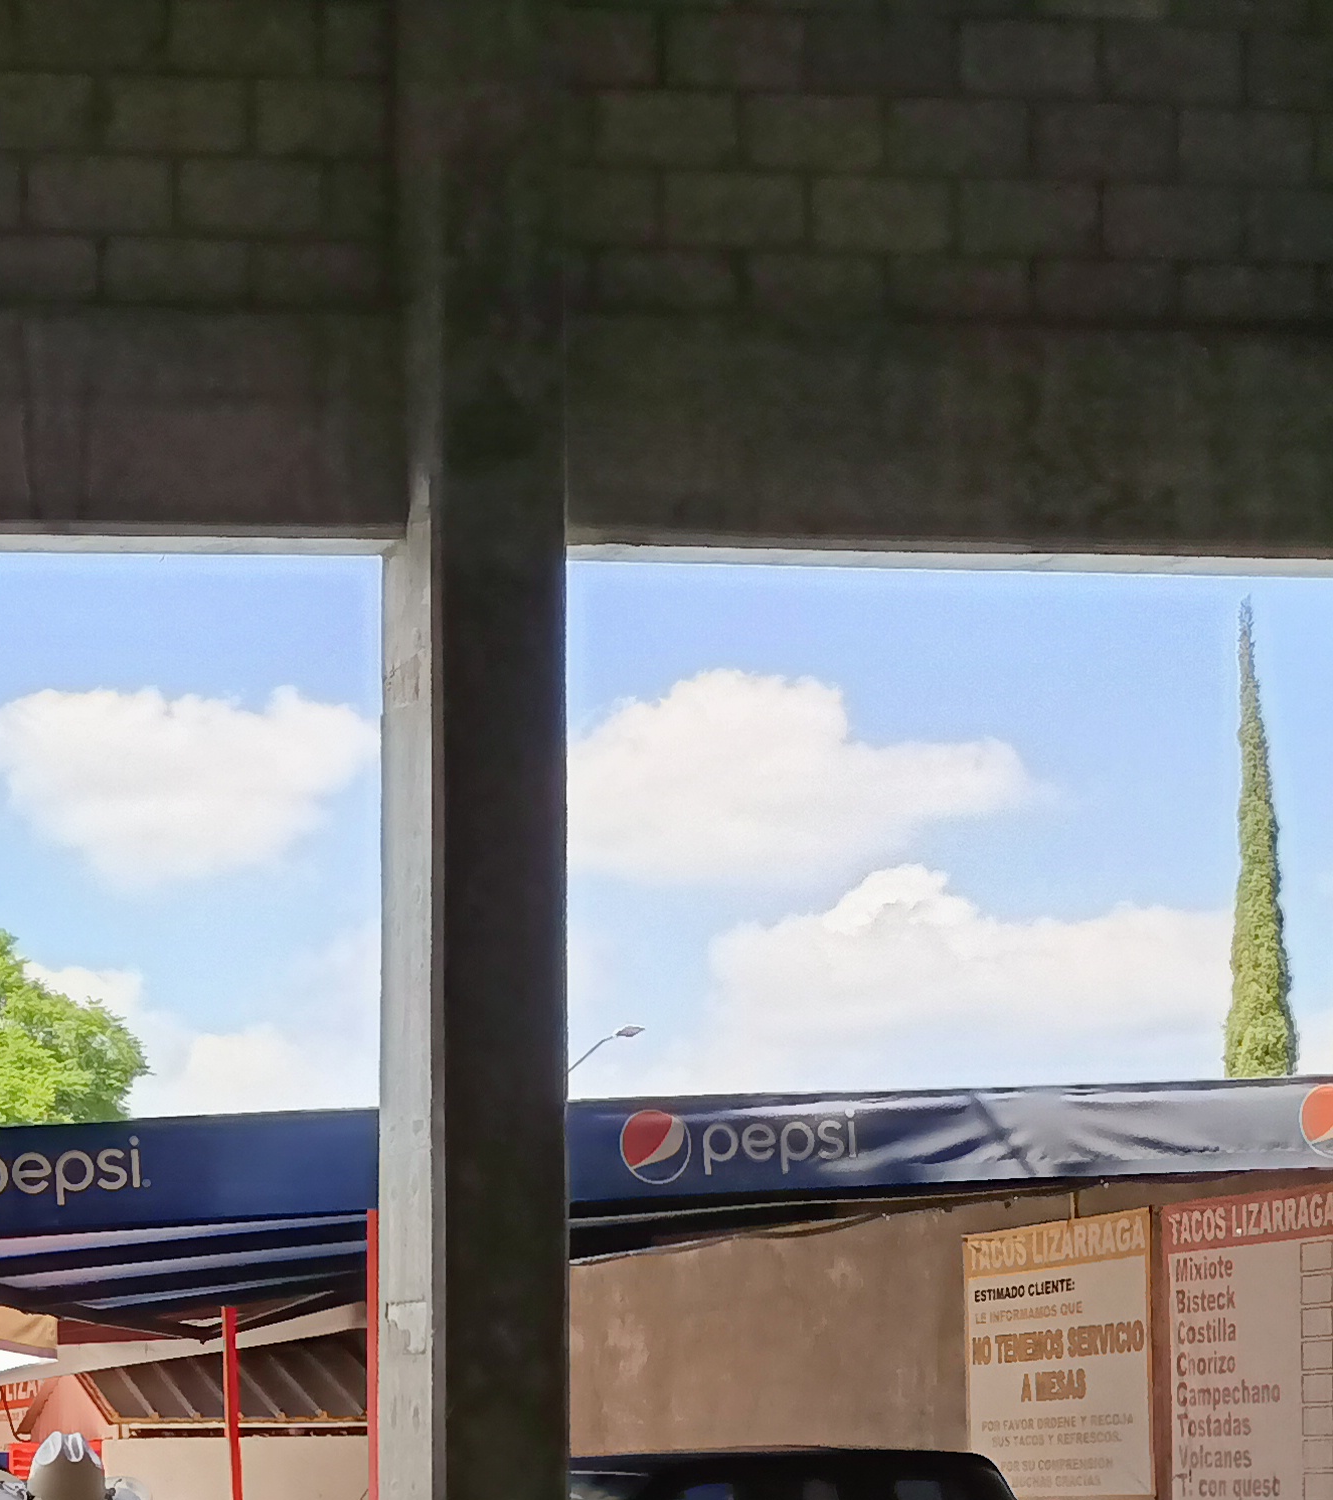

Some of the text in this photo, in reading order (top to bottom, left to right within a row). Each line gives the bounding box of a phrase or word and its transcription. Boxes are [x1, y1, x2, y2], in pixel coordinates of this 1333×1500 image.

[703, 1108, 860, 1176] pepsi
[1168, 1191, 1333, 1246] TACOS LIZARRAGA
[967, 1215, 1146, 1271] TACOS LIZARRAGA
[1175, 1255, 1234, 1283] Mixiote
[974, 1278, 1076, 1303] ESTIMADO CLIENTE:
[1176, 1285, 1236, 1314] Bisteck
[989, 1304, 1058, 1324] INFORMAMOS
[1060, 1301, 1084, 1316] QUE
[971, 1319, 1145, 1366] NO TENEMOS SERVICIO
[1177, 1317, 1237, 1345] Costilla
[1176, 1350, 1237, 1377] Chorizo
[1020, 1367, 1087, 1403] A MESAS
[1176, 1379, 1281, 1412] Campechano
[1002, 1418, 1034, 1432] FAVOR
[1080, 1415, 1087, 1427] Y
[1177, 1411, 1252, 1438] Tostadas
[1178, 1444, 1253, 1469] Volcanes
[1198, 1477, 1227, 1498] con
